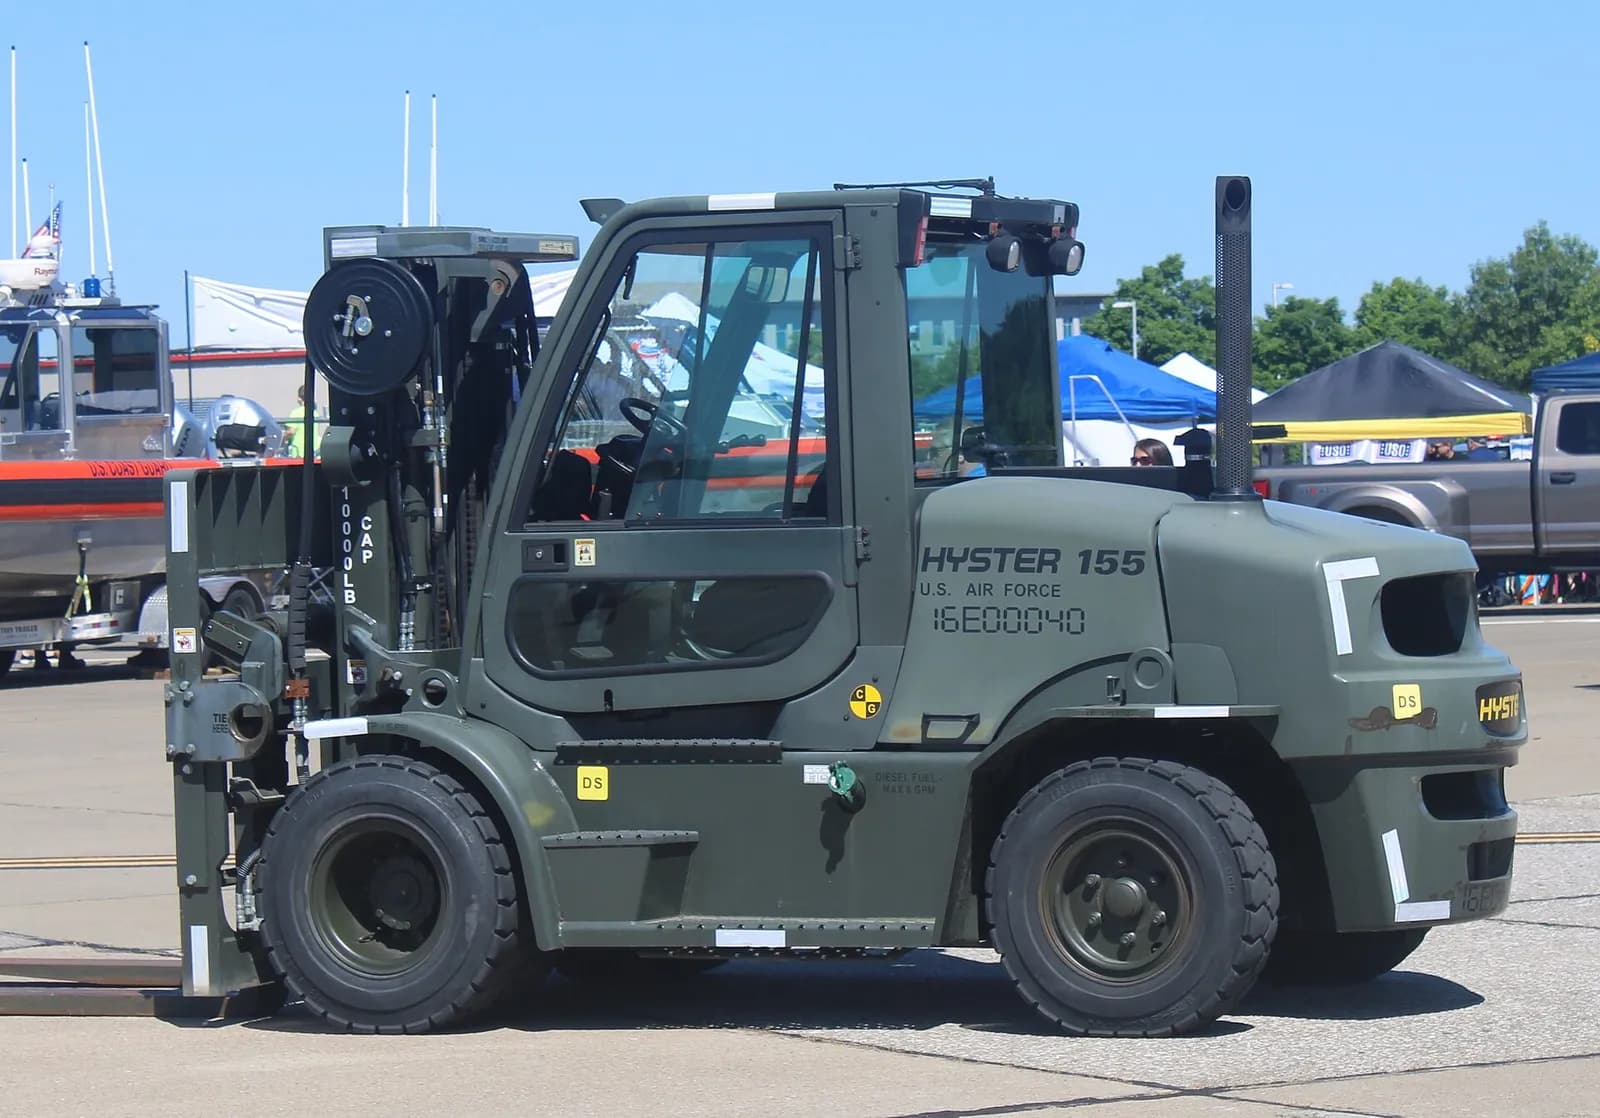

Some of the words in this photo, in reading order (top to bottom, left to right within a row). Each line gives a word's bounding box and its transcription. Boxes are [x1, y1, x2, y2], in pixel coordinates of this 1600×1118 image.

[1325, 444, 1346, 457] USO
[1384, 442, 1406, 457] USO
[108, 461, 139, 477] COAST
[920, 546, 1062, 574] HYSTER
[1078, 549, 1146, 576] 155
[919, 582, 951, 597] U.S.
[966, 583, 994, 597] AIR
[1004, 583, 1062, 598] FORCE
[934, 606, 1085, 635] 16E00040
[855, 689, 864, 700] C
[867, 703, 876, 713] G
[1398, 695, 1417, 708] DS
[213, 713, 227, 723] TIE
[583, 777, 603, 789] DS
